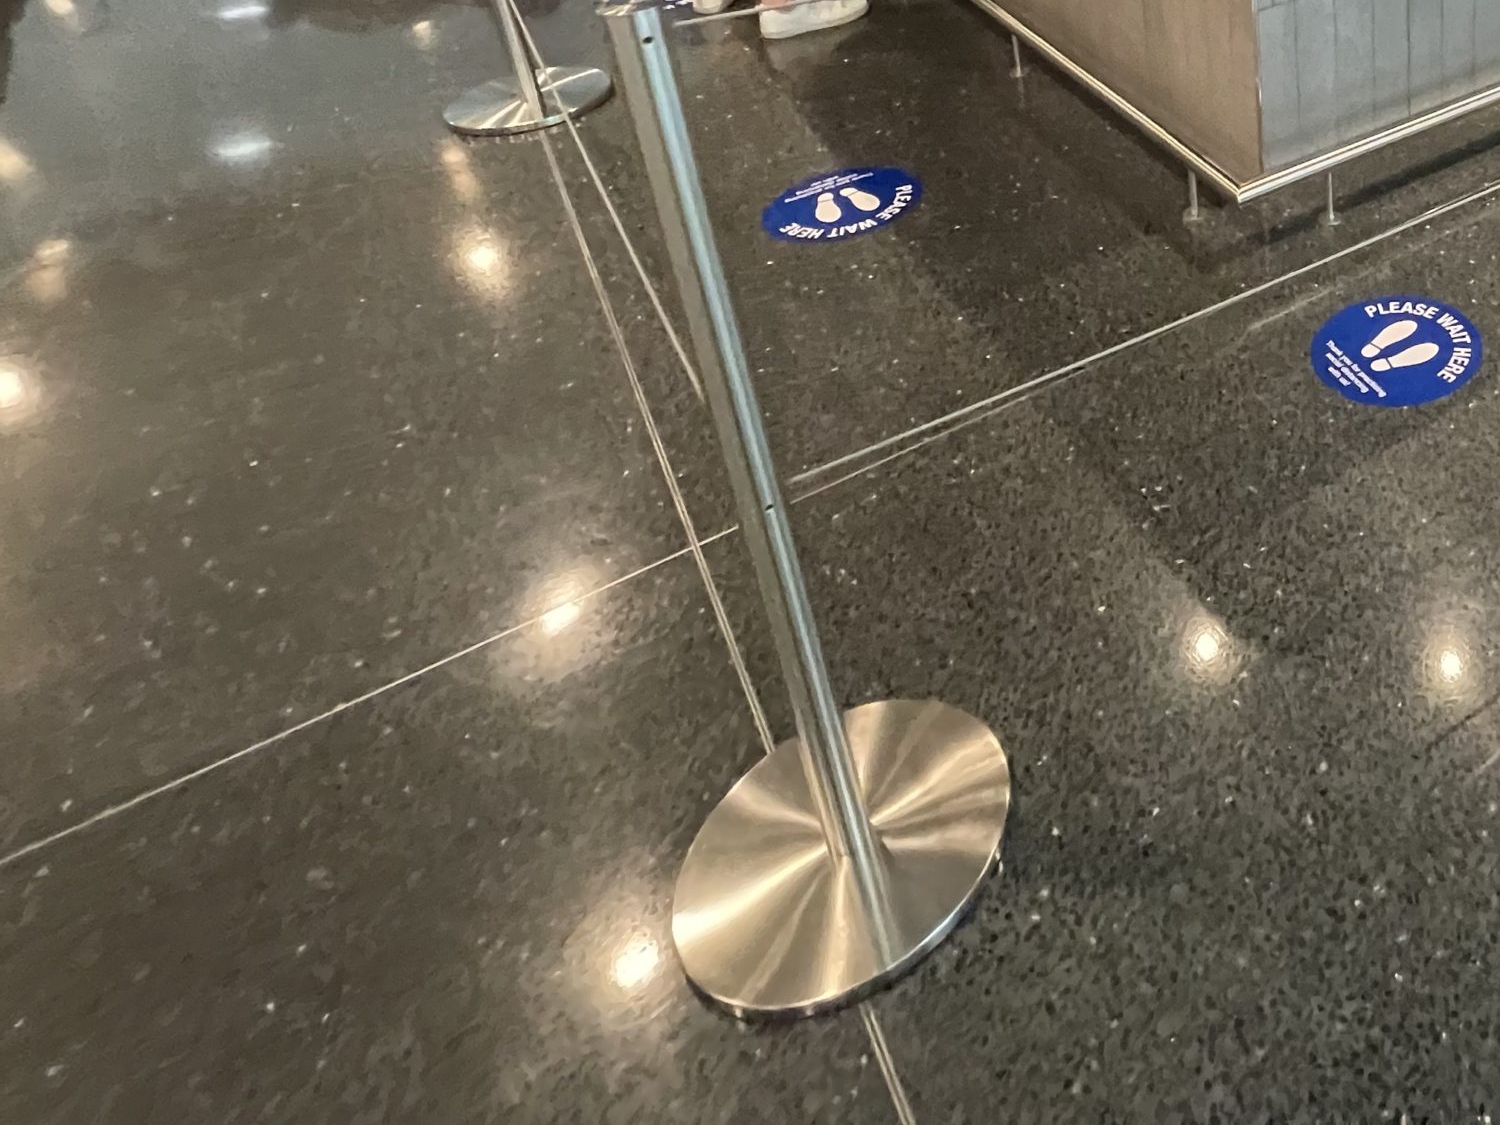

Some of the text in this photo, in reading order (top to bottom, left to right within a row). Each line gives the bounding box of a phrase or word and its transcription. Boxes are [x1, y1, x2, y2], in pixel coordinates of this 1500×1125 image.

[875, 184, 913, 221] PLEASE
[779, 222, 825, 239] HERE
[826, 218, 878, 239] WAIT
[1364, 301, 1472, 383] PLEASE WAIT HERE
